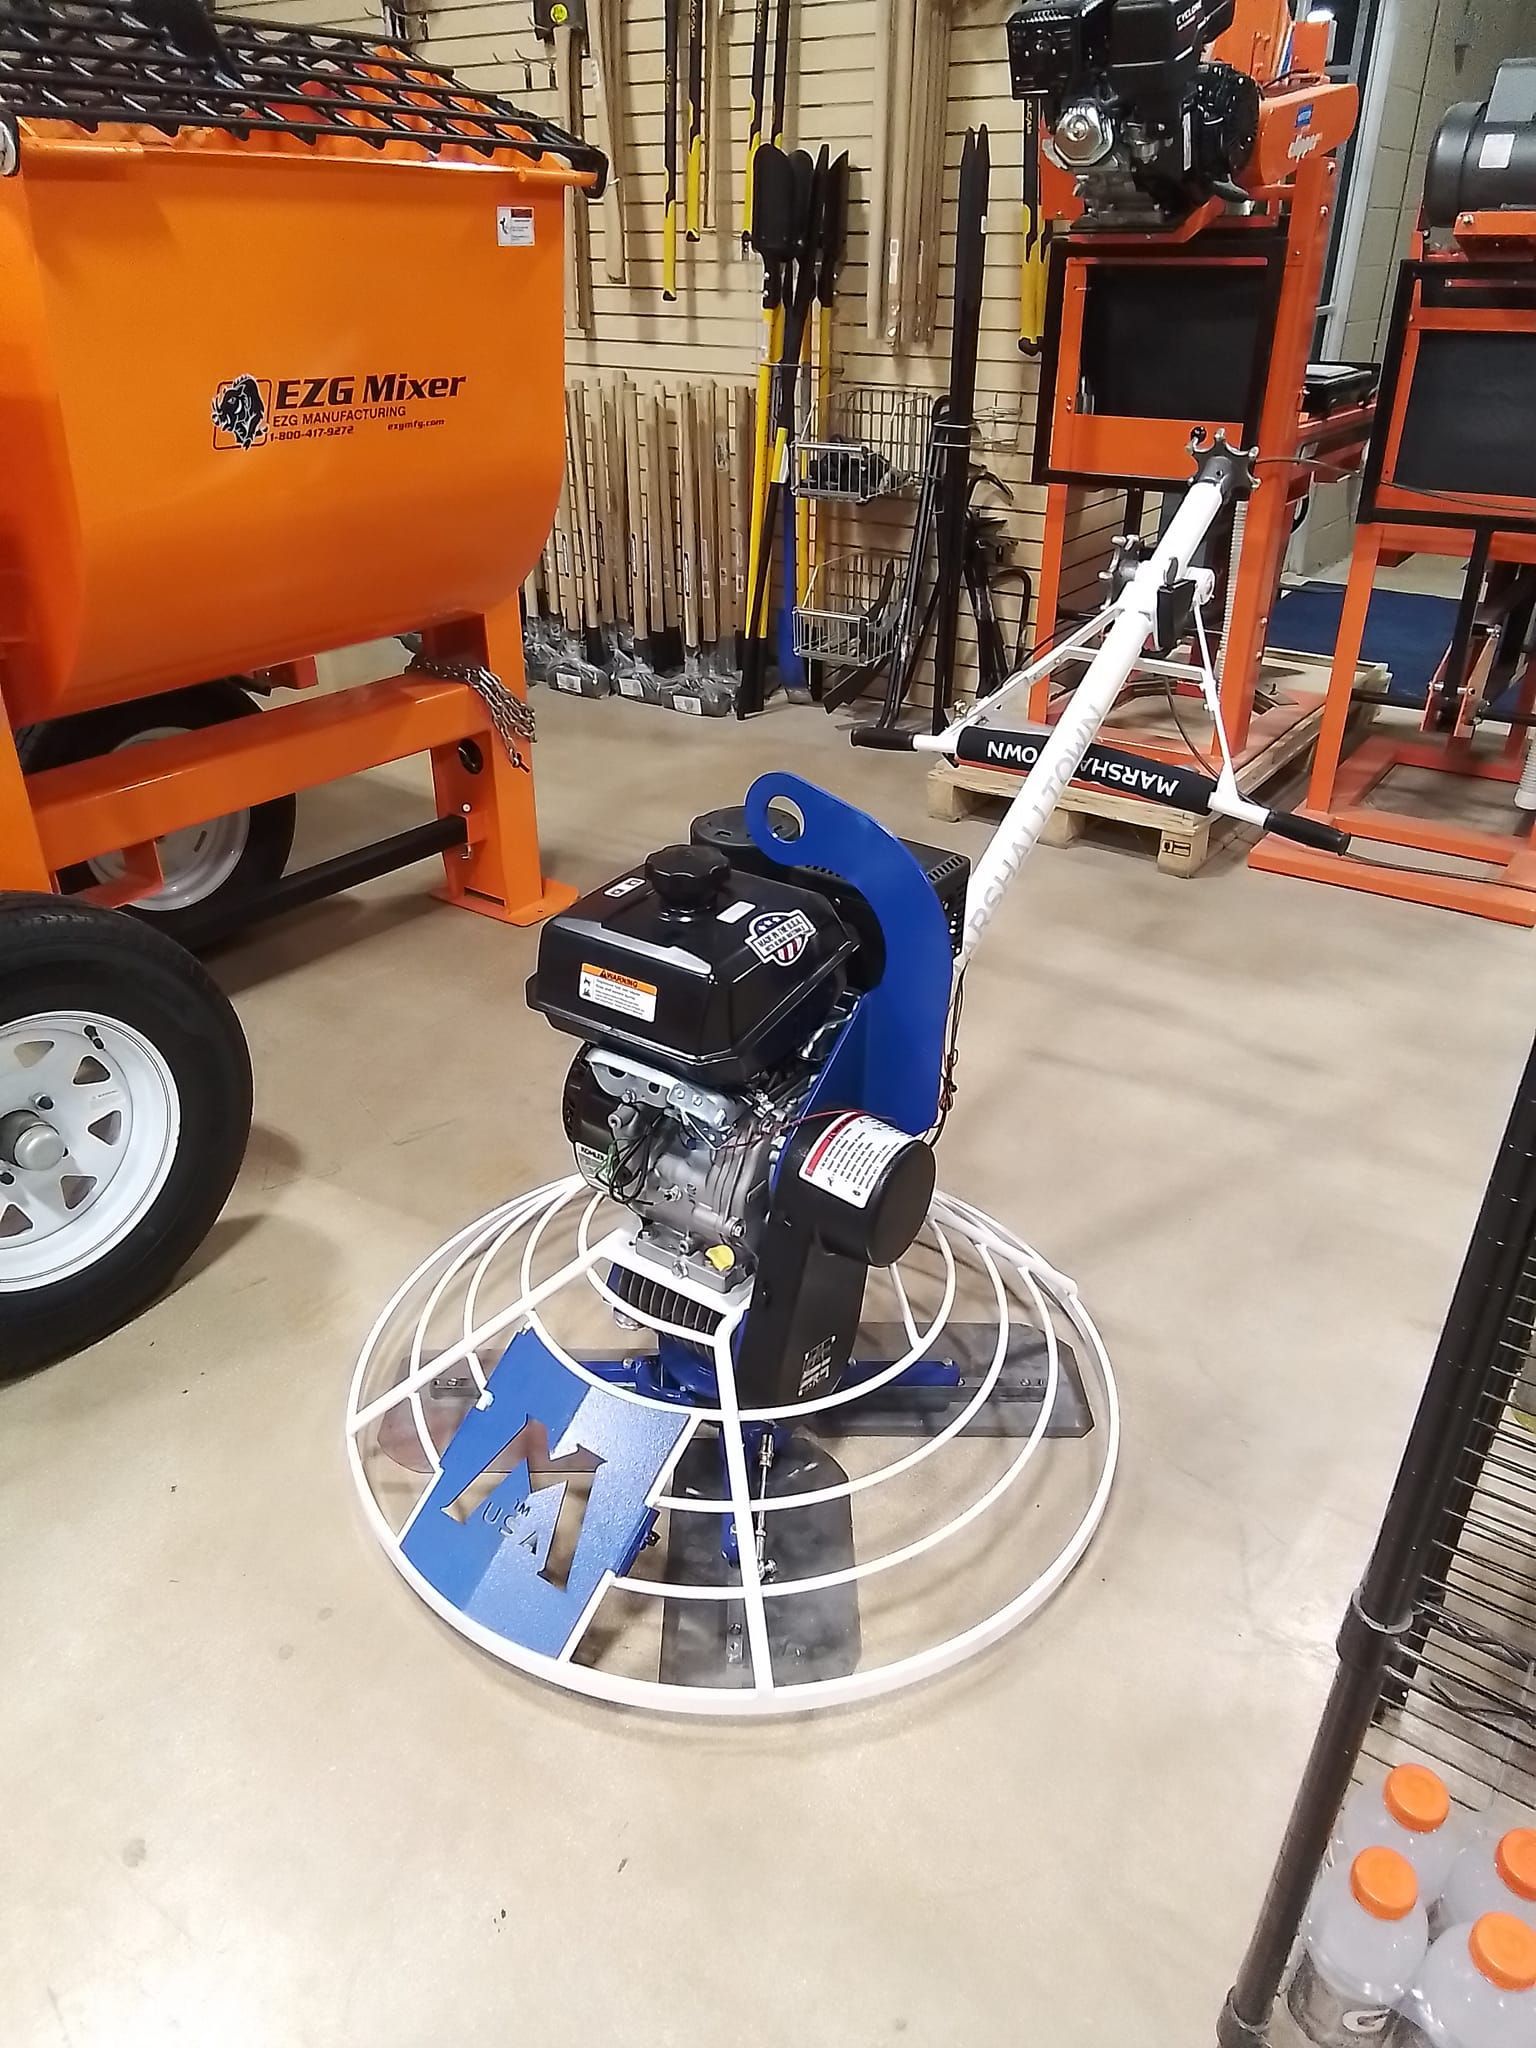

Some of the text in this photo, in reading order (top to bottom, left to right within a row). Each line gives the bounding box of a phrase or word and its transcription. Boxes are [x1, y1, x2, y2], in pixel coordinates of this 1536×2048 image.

[275, 373, 467, 409] EZG Mixer
[272, 406, 407, 427] EZG MANUFACTURING
[270, 426, 354, 442] 1-800-417-9272
[605, 973, 638, 988] WARNING
[481, 1501, 538, 1556] USA
